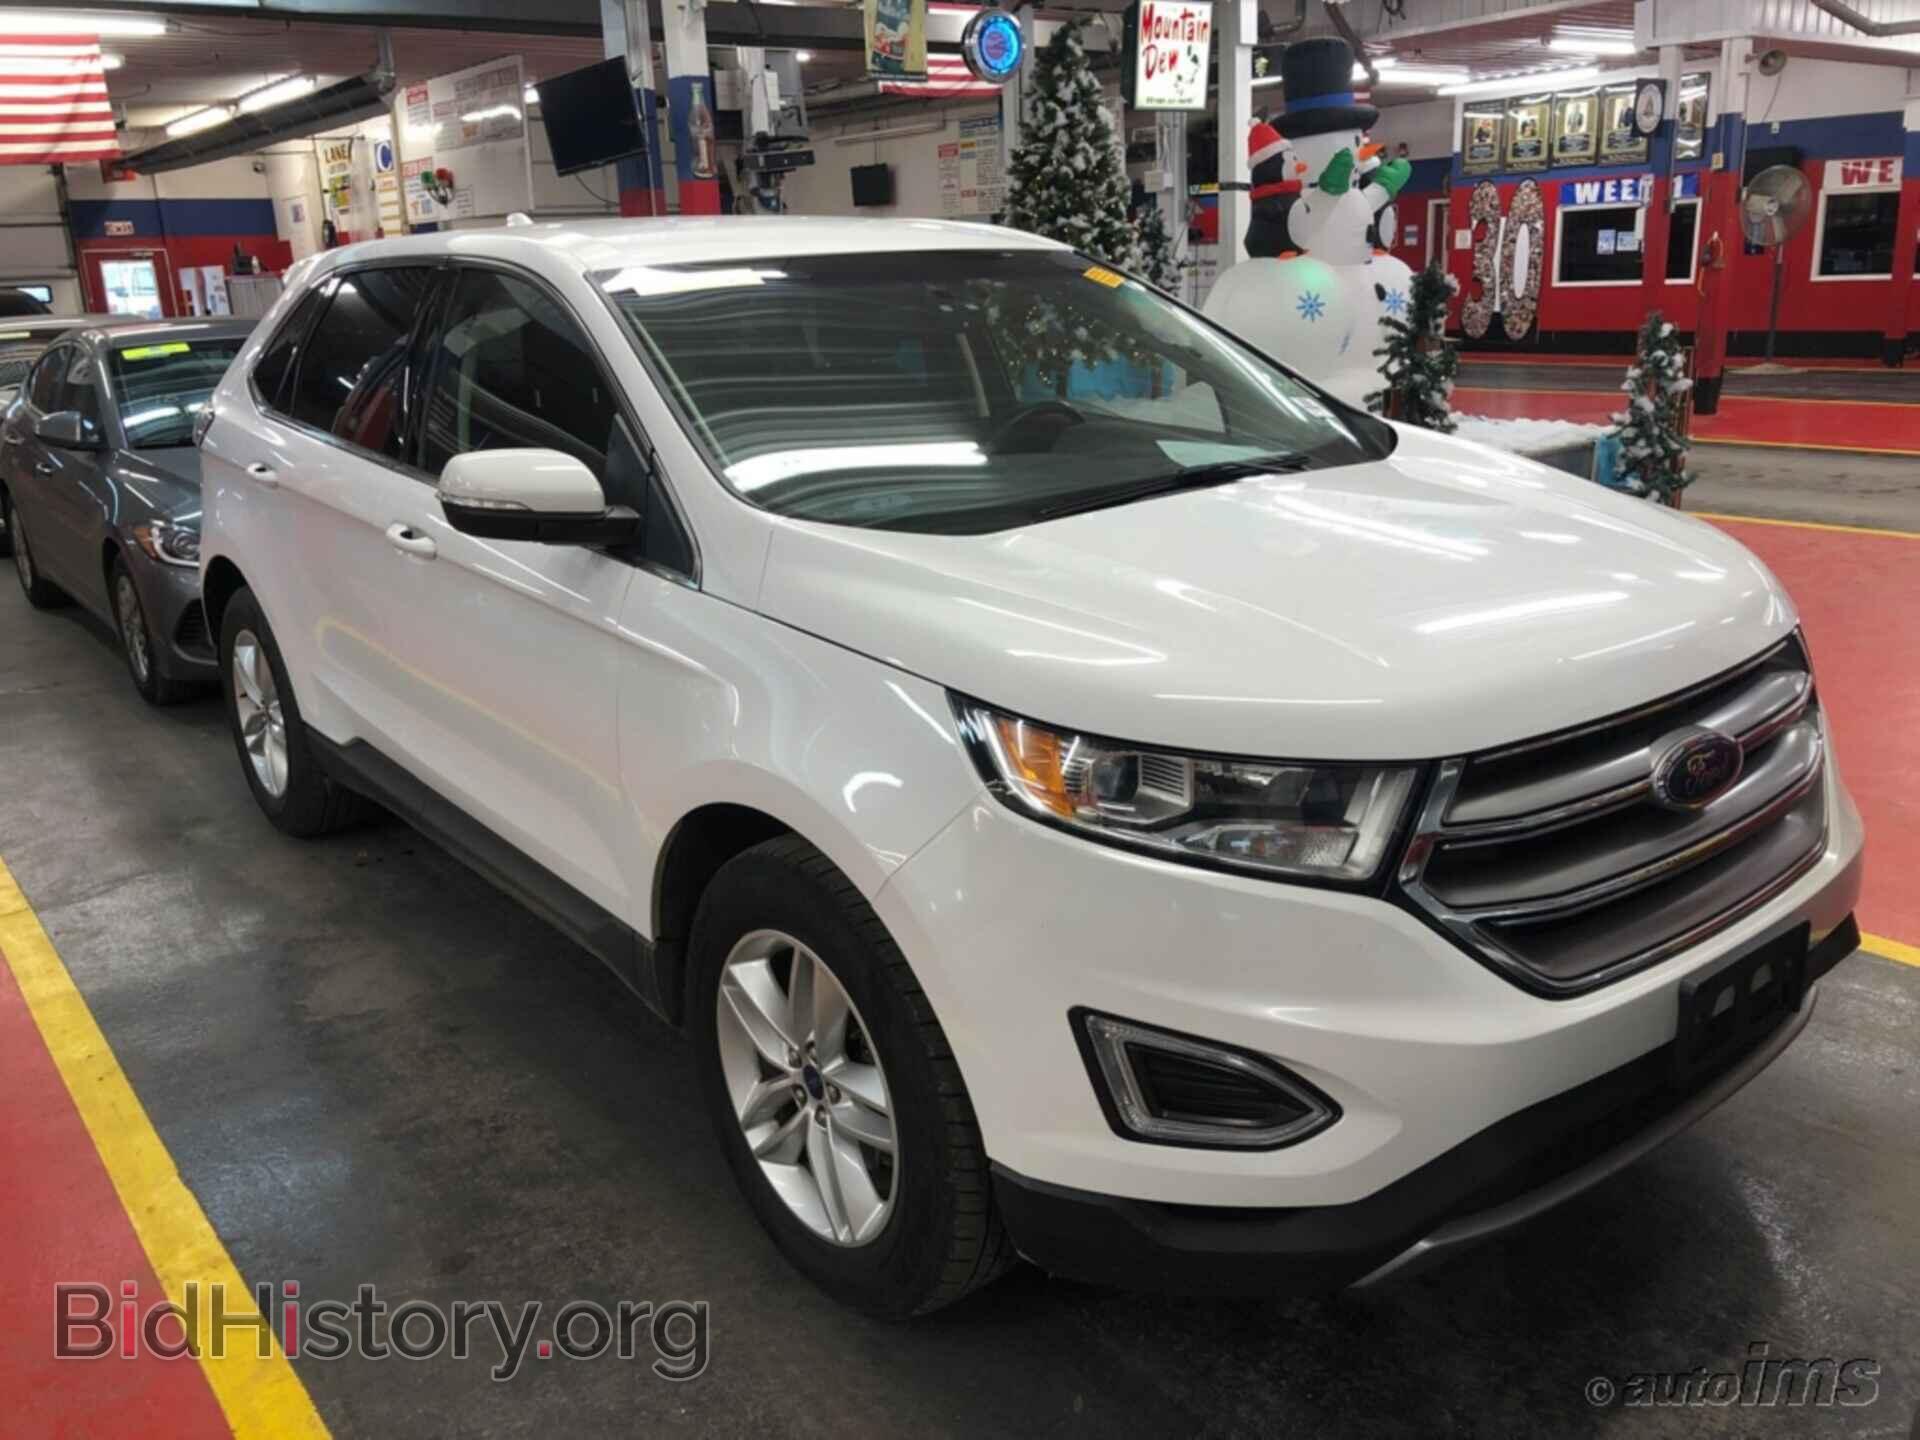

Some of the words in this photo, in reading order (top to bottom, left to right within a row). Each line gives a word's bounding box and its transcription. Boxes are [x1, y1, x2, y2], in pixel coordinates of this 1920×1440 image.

[1141, 2, 1209, 43] Mountain
[1142, 44, 1179, 80] Dew
[376, 141, 394, 172] C
[1575, 178, 1643, 204] WEE
